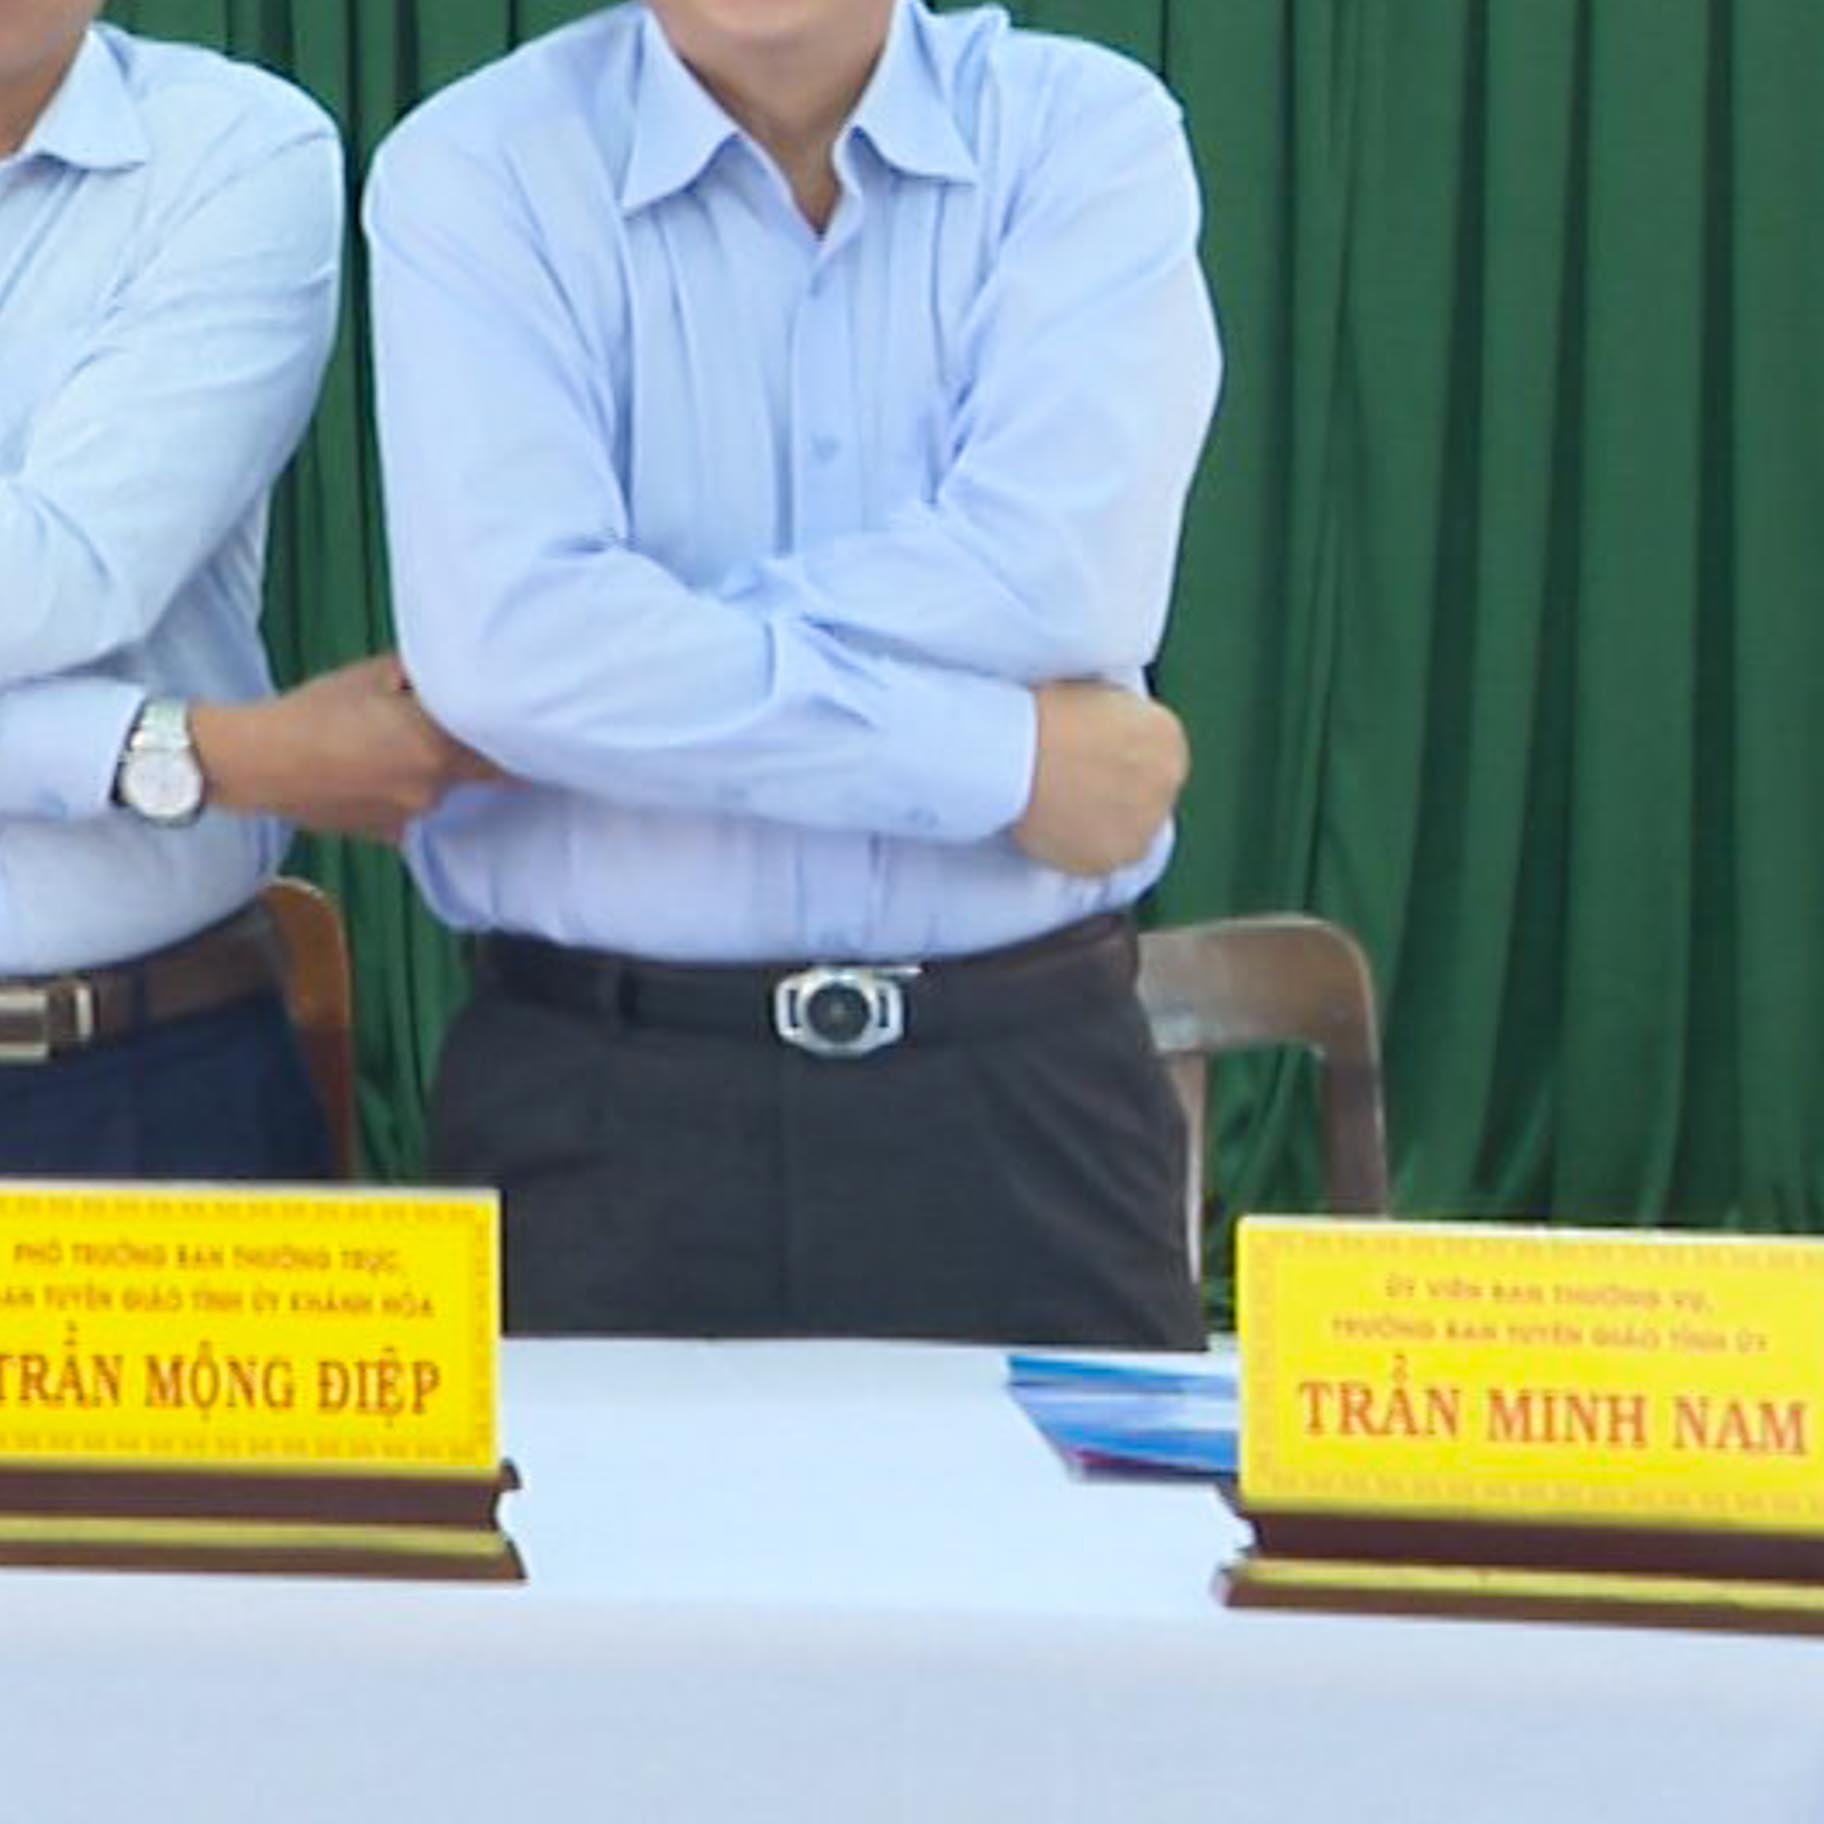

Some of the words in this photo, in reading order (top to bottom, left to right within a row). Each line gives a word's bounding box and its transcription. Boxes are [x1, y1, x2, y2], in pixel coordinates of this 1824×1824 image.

[143, 1337, 297, 1423] MỘNG
[317, 1345, 442, 1428] ĐIỆP
[1486, 1387, 1647, 1451] MINH
[1672, 1397, 1810, 1457] NAM
